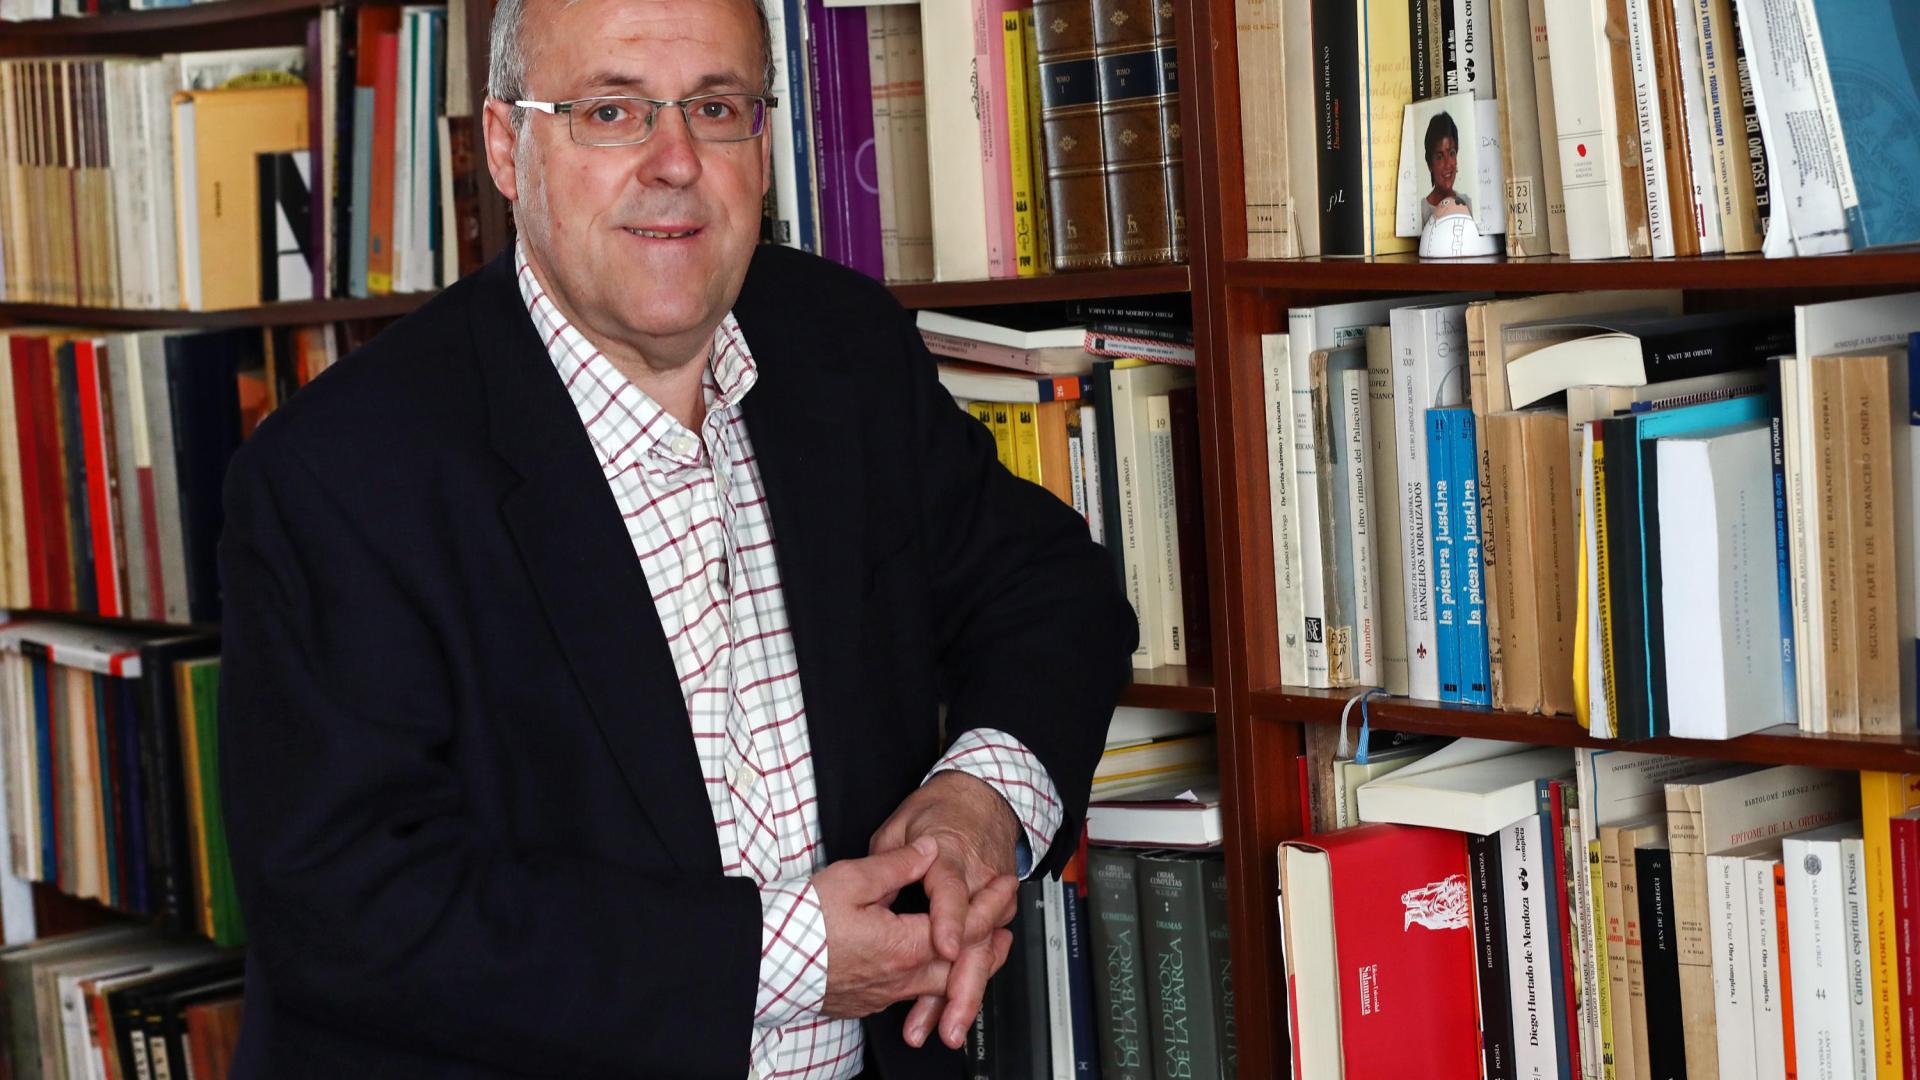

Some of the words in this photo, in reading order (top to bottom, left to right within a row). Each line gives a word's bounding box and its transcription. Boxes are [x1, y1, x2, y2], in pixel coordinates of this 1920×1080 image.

[1465, 18, 1474, 53] Obras
[1702, 16, 1712, 39] SEVILLA
[1418, 38, 1423, 50] DE
[1704, 40, 1714, 58] REINA
[1116, 67, 1130, 76] TOMO
[1168, 72, 1176, 80] III
[1707, 60, 1715, 69] LA
[1056, 74, 1070, 83] TOMO
[1709, 75, 1720, 104] VIRTUOSA
[1737, 56, 1756, 107] DEMONIO
[1324, 91, 1331, 100] DE
[1638, 82, 1651, 135] AMESCUA
[1744, 112, 1760, 132] DEL
[1644, 140, 1653, 152] DE
[1717, 138, 1724, 146] LA
[1646, 158, 1656, 186] MIRA
[1719, 151, 1728, 184] AMESCUA
[1746, 137, 1766, 187] ESCLAVO
[1834, 154, 1848, 186] batalla
[1517, 186, 1528, 197] 23
[1755, 190, 1768, 206] EL
[1648, 190, 1662, 240] ANTONIO
[1724, 198, 1732, 215] MIRA
[1088, 308, 1106, 316] BARCA
[1108, 308, 1114, 316] LA
[1117, 308, 1124, 316] DE
[1667, 352, 1682, 360] LUNA
[1406, 375, 1414, 404] MORENO
[1156, 418, 1165, 428] 19
[1352, 408, 1362, 442] Palacio
[1408, 405, 1416, 433] JIMÉNEZ
[1860, 394, 1870, 445] GENERAL
[1772, 418, 1782, 447] Ramón
[1353, 448, 1362, 462] del
[1774, 449, 1782, 465] Llull
[1122, 456, 1131, 487] ABSALÓN
[1824, 446, 1834, 520] ROMANCERO
[1126, 490, 1132, 498] DE
[1354, 469, 1364, 503] rimado
[1776, 474, 1784, 495] Libro
[1862, 452, 1874, 527] ROMANCERO
[1280, 496, 1286, 507] De
[1434, 480, 1453, 544] justina
[1462, 480, 1480, 544] justina
[1126, 502, 1134, 534] CABELLOS
[1356, 508, 1366, 535] Libro
[1414, 481, 1426, 556] MORALIZADOS
[1777, 520, 1786, 546] orden
[1828, 530, 1836, 549] DEL
[1866, 536, 1874, 555] DEL
[1408, 530, 1416, 570] SALAMANCA
[1410, 571, 1416, 580] DE
[1436, 548, 1456, 604] pícara
[1464, 548, 1484, 604] pícara
[1829, 556, 1838, 591] PARTE
[1866, 562, 1876, 598] PARTE
[1418, 558, 1428, 621] EVANGELIOS
[1439, 609, 1452, 624] la
[1467, 609, 1482, 625] la
[1831, 600, 1839, 653] SEGUNDA
[1362, 618, 1373, 666] Alhambra
[1868, 606, 1878, 660] SEGUNDA
[1744, 791, 1779, 808] BARTOLOMÉ
[1782, 786, 1809, 800] JIMÉNEZ
[1518, 826, 1527, 862] completa
[1731, 828, 1763, 846] EPÍTOME
[1768, 824, 1778, 837] DE
[1783, 821, 1794, 833] LA
[1098, 870, 1132, 881] COMPLETAS
[1105, 864, 1124, 872] OBRAS
[1156, 871, 1175, 880] OBRAS
[1478, 852, 1488, 890] MENDOZA
[1846, 853, 1859, 896] Poesías
[1150, 877, 1183, 888] COMPLETAS
[1607, 881, 1618, 889] 182
[1724, 882, 1732, 900] Juan
[1066, 888, 1077, 921] DUENDE
[1482, 892, 1489, 902] DE
[1654, 877, 1664, 914] JAUREGUI
[1726, 902, 1732, 910] de
[1156, 920, 1183, 930] DRAMAS
[1483, 905, 1492, 942] HURTADO
[1520, 896, 1532, 948] Mendoza
[1657, 917, 1663, 928] DE
[1726, 922, 1734, 940] Cruz
[1814, 920, 1820, 931] DE
[1849, 900, 1864, 956] espiritual
[1070, 924, 1078, 946] DAMA
[1658, 930, 1666, 950] JUAN
[1760, 928, 1768, 946] Cruz
[1815, 933, 1821, 944] LA
[1878, 911, 1888, 966] FORTUNA
[1072, 946, 1079, 958] LA
[1486, 944, 1494, 968] DIEGO
[1524, 950, 1534, 964] de
[1118, 929, 1136, 1002] BARCA
[1169, 937, 1187, 1012] BARCA
[1582, 963, 1590, 984] JAQUE
[1880, 970, 1888, 984] LA
[1362, 966, 1373, 1016] Salamanca
[1524, 966, 1537, 1013] Hurtado
[1583, 986, 1589, 996] DE
[1728, 964, 1737, 998] completa,
[1762, 970, 1770, 1005] completa,
[1852, 960, 1864, 1005] Cántico
[1106, 944, 1128, 1068] CALDERÓN
[1816, 988, 1826, 1000] 44
[1882, 986, 1889, 1002] DE
[1122, 1006, 1138, 1034] LA
[1158, 952, 1179, 1078] CALDERÓN
[976, 1030, 984, 1046] HAY
[1174, 1016, 1189, 1044] LA
[1528, 1014, 1539, 1047] Diego
[1858, 1019, 1866, 1037] Cruz
[1882, 1006, 1892, 1066] FRACASOS
[977, 1046, 985, 1060] NO
[1126, 1038, 1140, 1068] DE
[1177, 1049, 1192, 1079] DE
